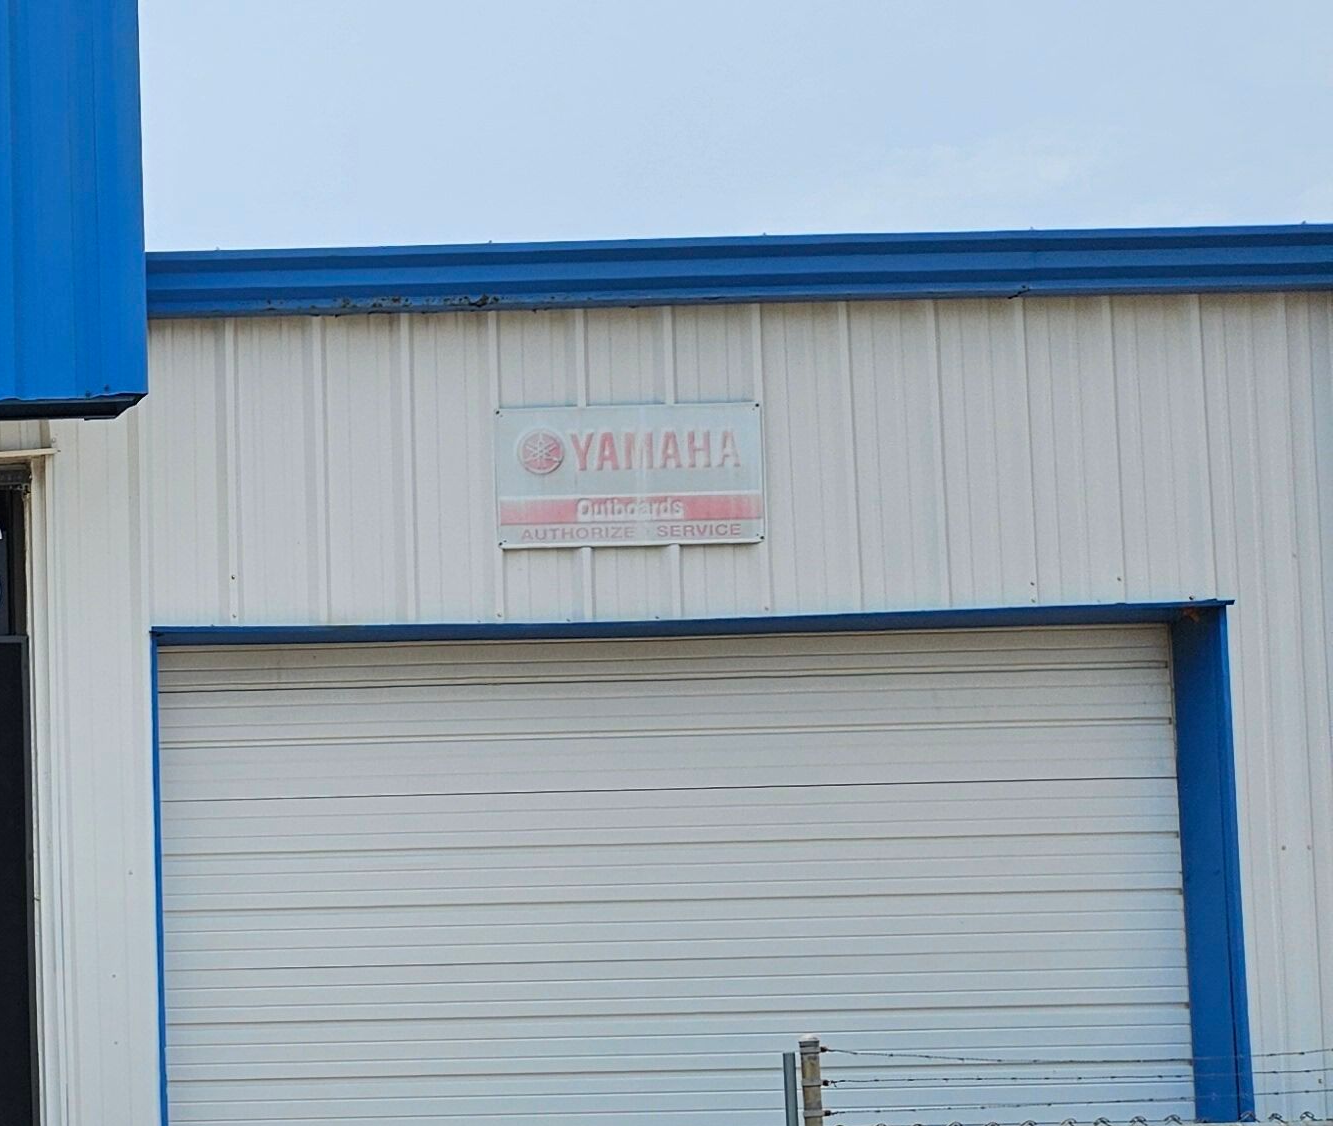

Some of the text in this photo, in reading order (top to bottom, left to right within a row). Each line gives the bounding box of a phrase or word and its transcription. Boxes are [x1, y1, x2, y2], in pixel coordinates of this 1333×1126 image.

[570, 430, 742, 472] YAMAHA
[576, 497, 684, 517] Outboards
[657, 523, 742, 538] SERVICE
